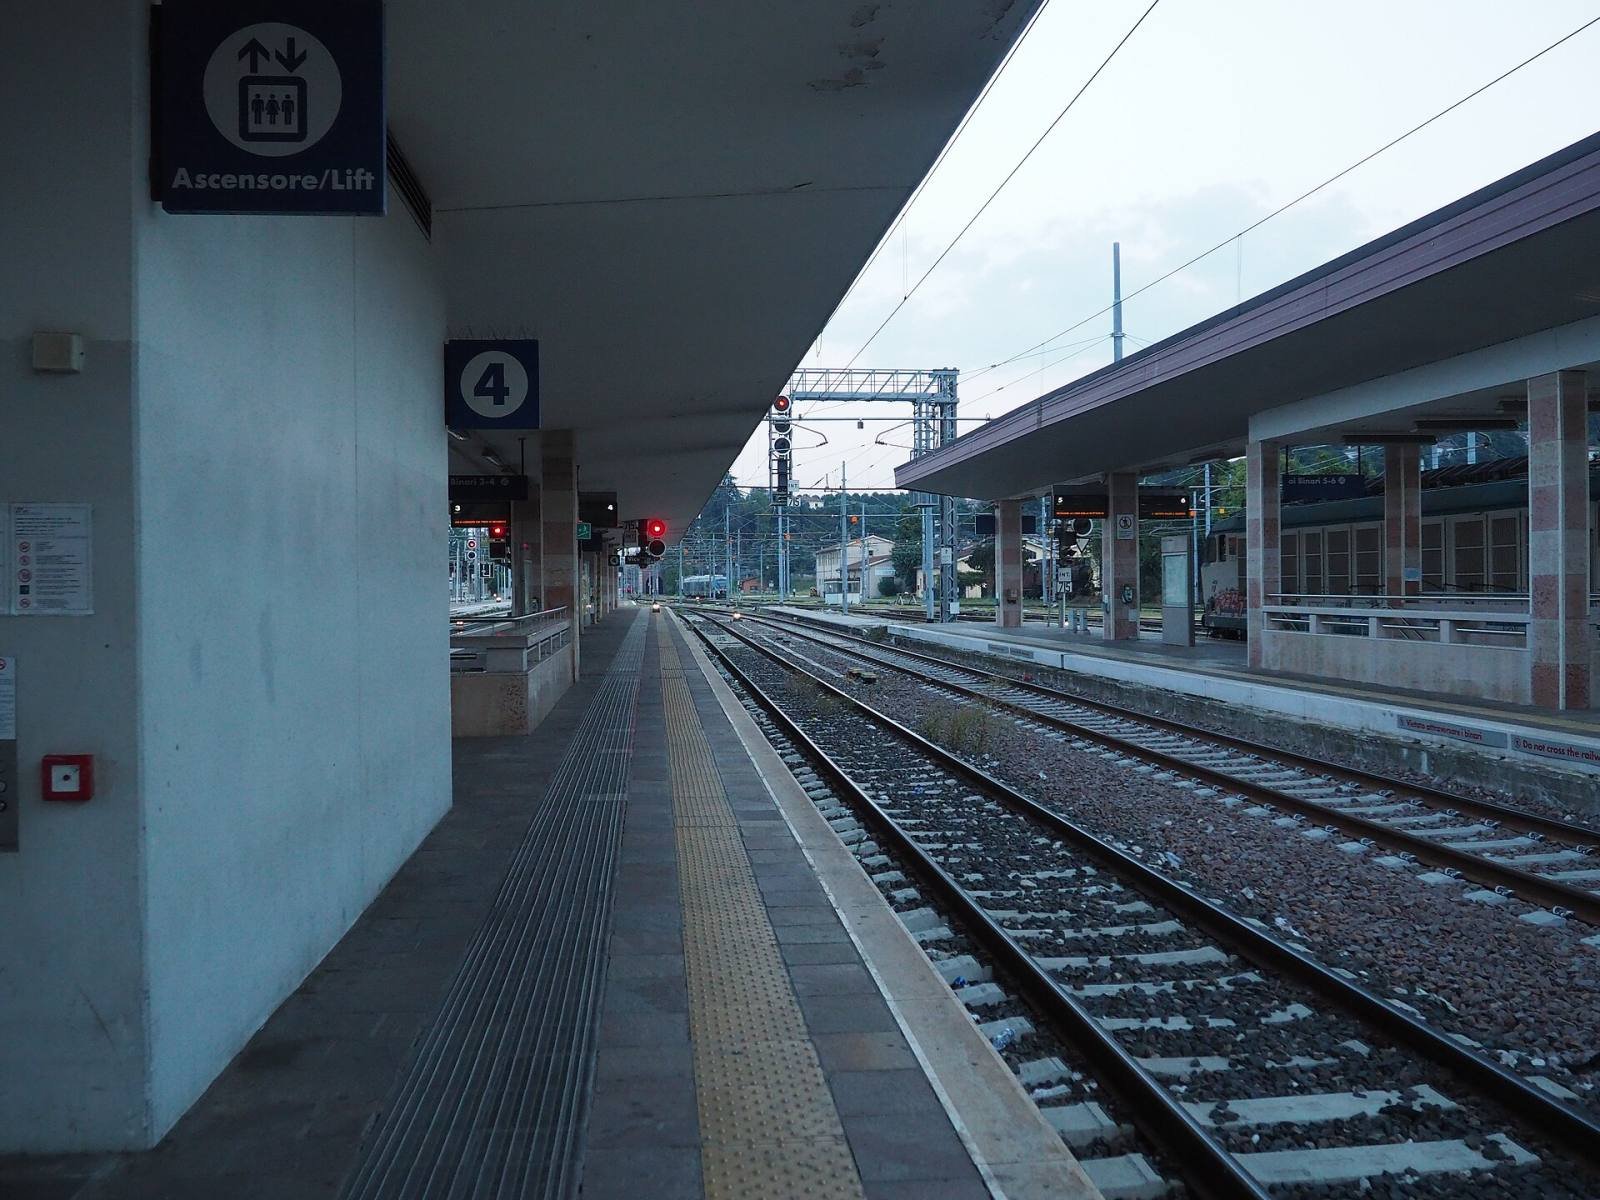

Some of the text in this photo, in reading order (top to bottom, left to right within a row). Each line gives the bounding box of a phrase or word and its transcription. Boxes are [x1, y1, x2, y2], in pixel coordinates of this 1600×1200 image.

[171, 167, 375, 191] Ascensore/Lift
[474, 363, 509, 405] 4
[1464, 729, 1482, 740] binari
[1523, 739, 1533, 749] Do
[1534, 743, 1546, 752] not
[1547, 746, 1565, 755] cross
[1567, 746, 1580, 758] the
